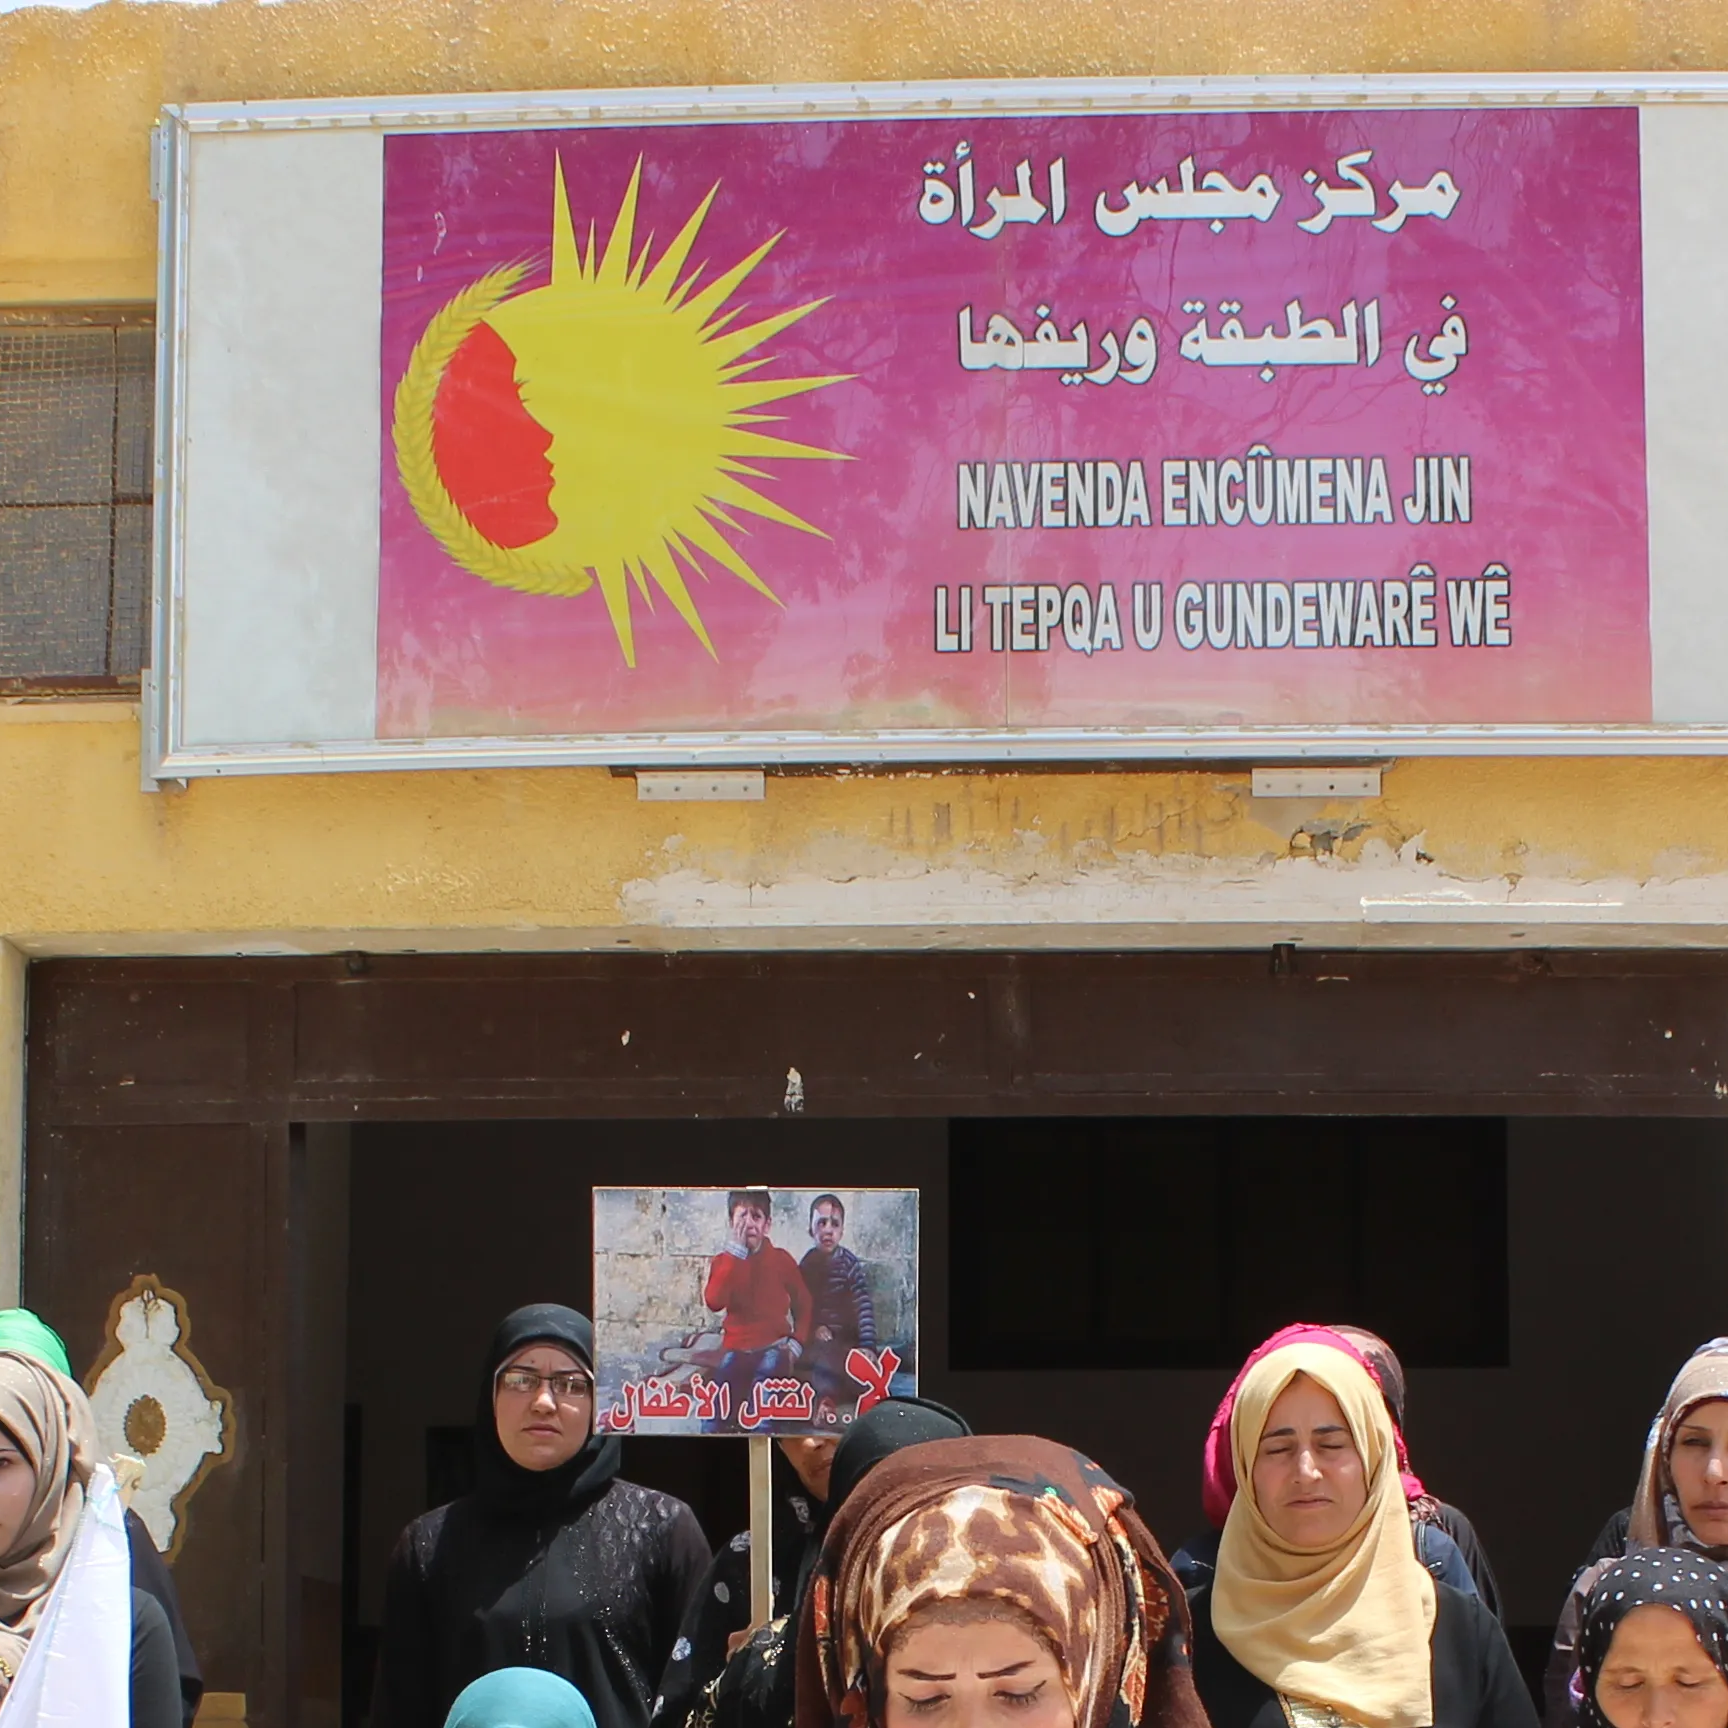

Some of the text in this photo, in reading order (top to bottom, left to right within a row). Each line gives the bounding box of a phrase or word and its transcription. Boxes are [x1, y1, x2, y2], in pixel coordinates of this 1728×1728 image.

[918, 140, 1461, 240] مركز مجلس المرأة
[958, 295, 1469, 396] في الطبقة وريفها
[957, 443, 1472, 529] NAVENDA ENCÛMENA JIN
[934, 562, 1512, 657] LI TEPQA U GUNDEWARÊ WÊ
[610, 1373, 731, 1431] الأطفال
[738, 1377, 816, 1430] لقتل
